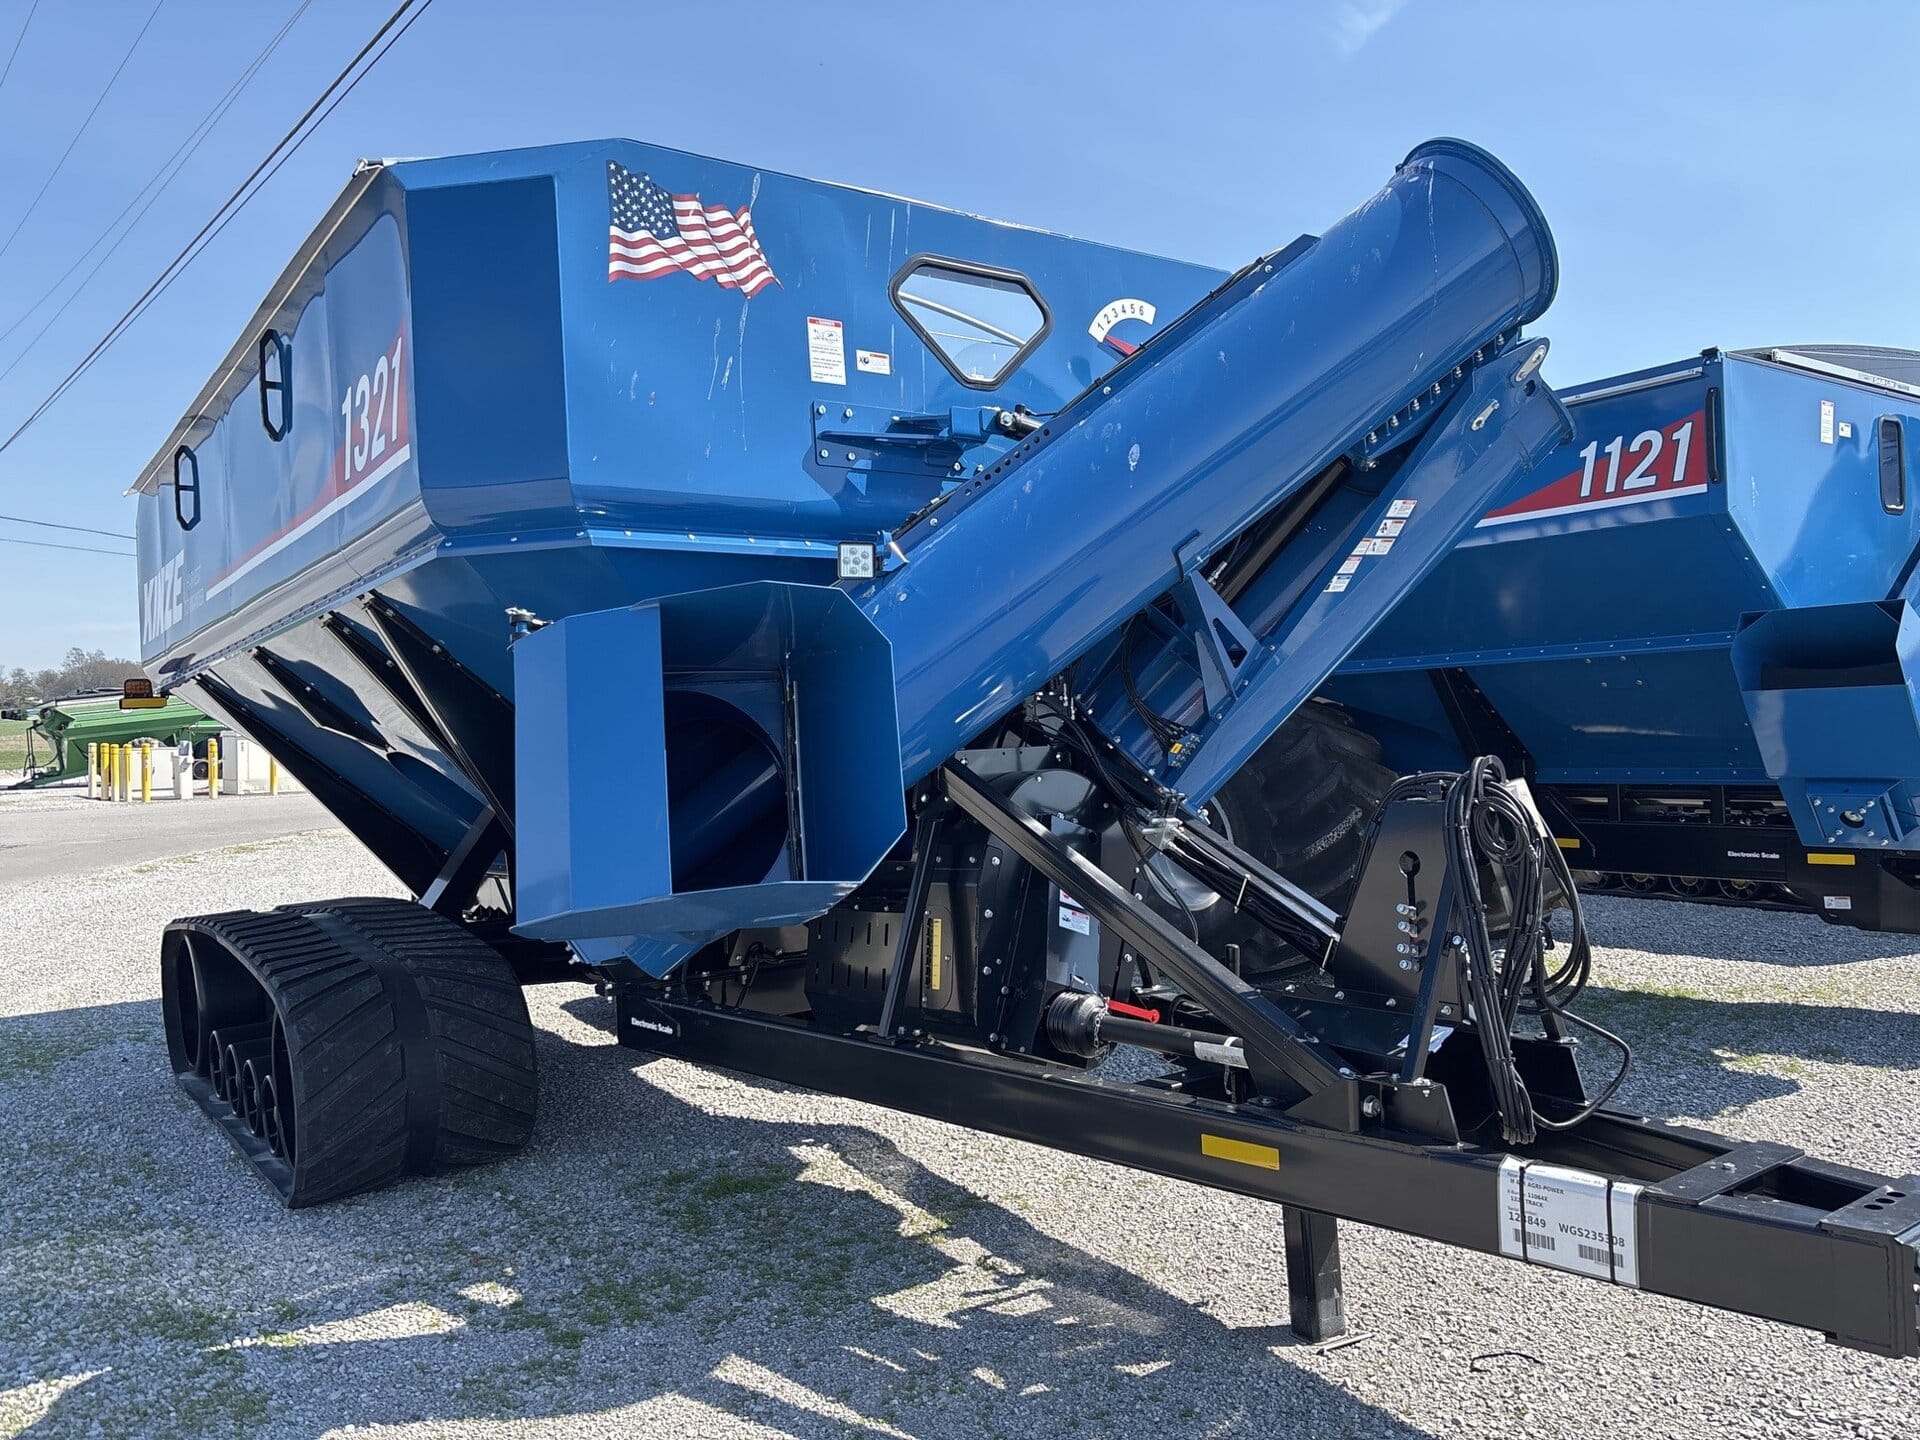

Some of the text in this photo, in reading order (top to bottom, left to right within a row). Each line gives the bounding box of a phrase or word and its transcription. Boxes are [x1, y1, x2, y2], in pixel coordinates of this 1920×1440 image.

[1097, 303, 1144, 331] 1 2 3 4 5 6
[341, 336, 402, 481] 1321
[1579, 421, 1693, 497] 1121
[143, 549, 185, 646] KINZE
[1727, 850, 1780, 859] Electronic Scale
[631, 1017, 673, 1035] Electronic Scale
[1527, 1182, 1565, 1195] AGRI-POWER
[1508, 1211, 1546, 1228] 12849
